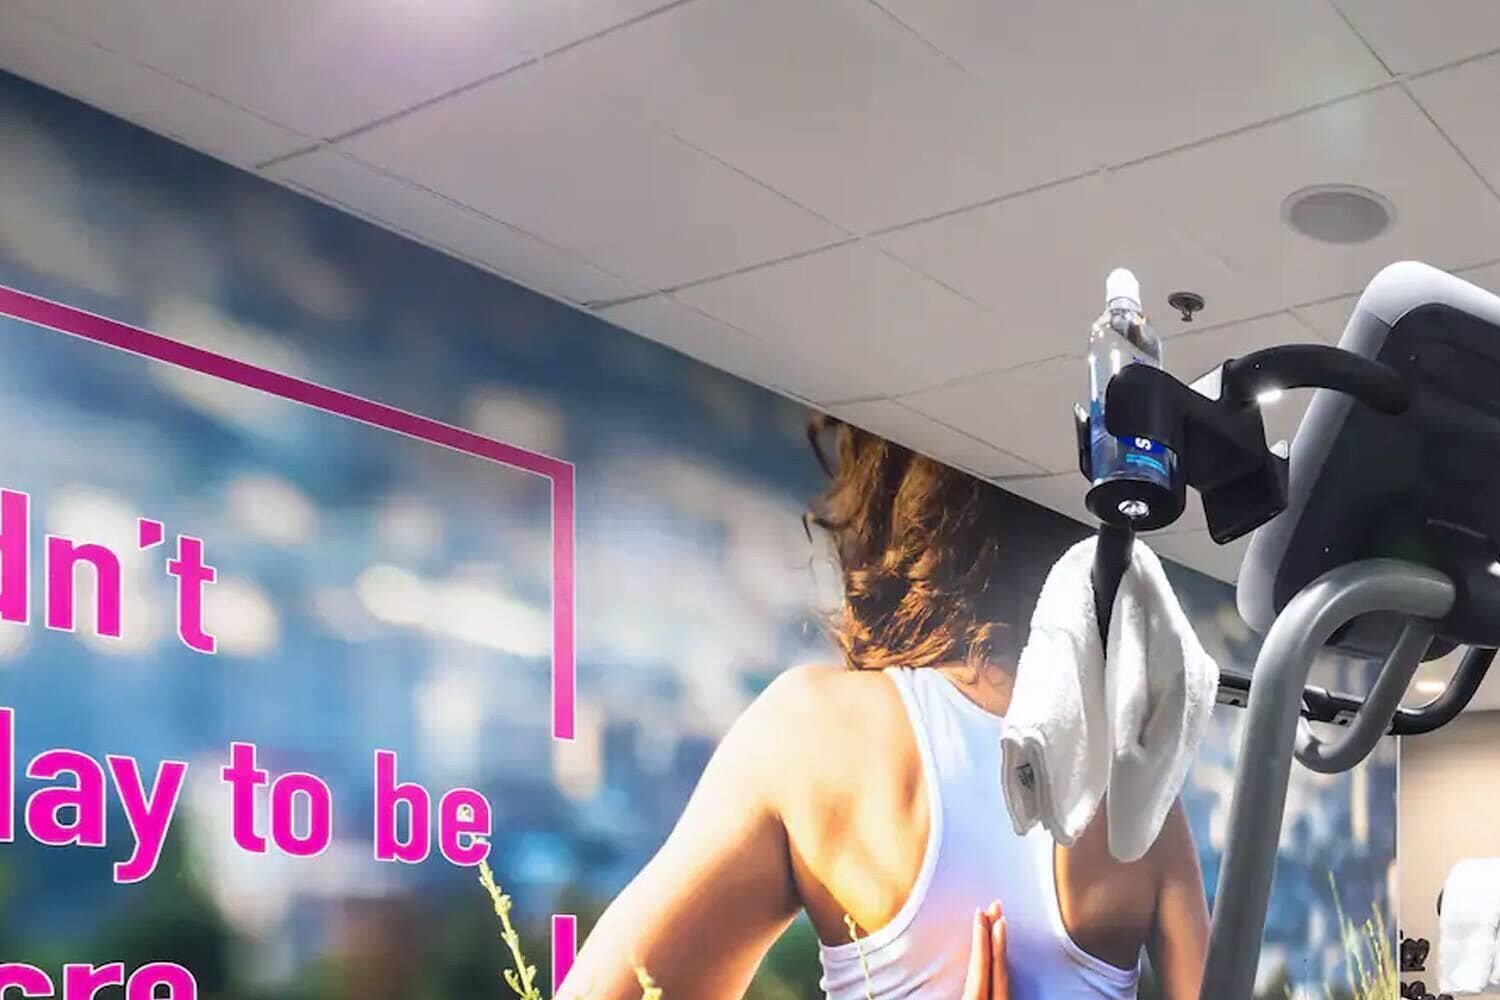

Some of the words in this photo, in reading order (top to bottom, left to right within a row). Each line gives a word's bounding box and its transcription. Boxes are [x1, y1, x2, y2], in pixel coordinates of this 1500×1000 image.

[0, 706, 189, 883] ay
[221, 741, 333, 857] to
[374, 749, 492, 866] be
